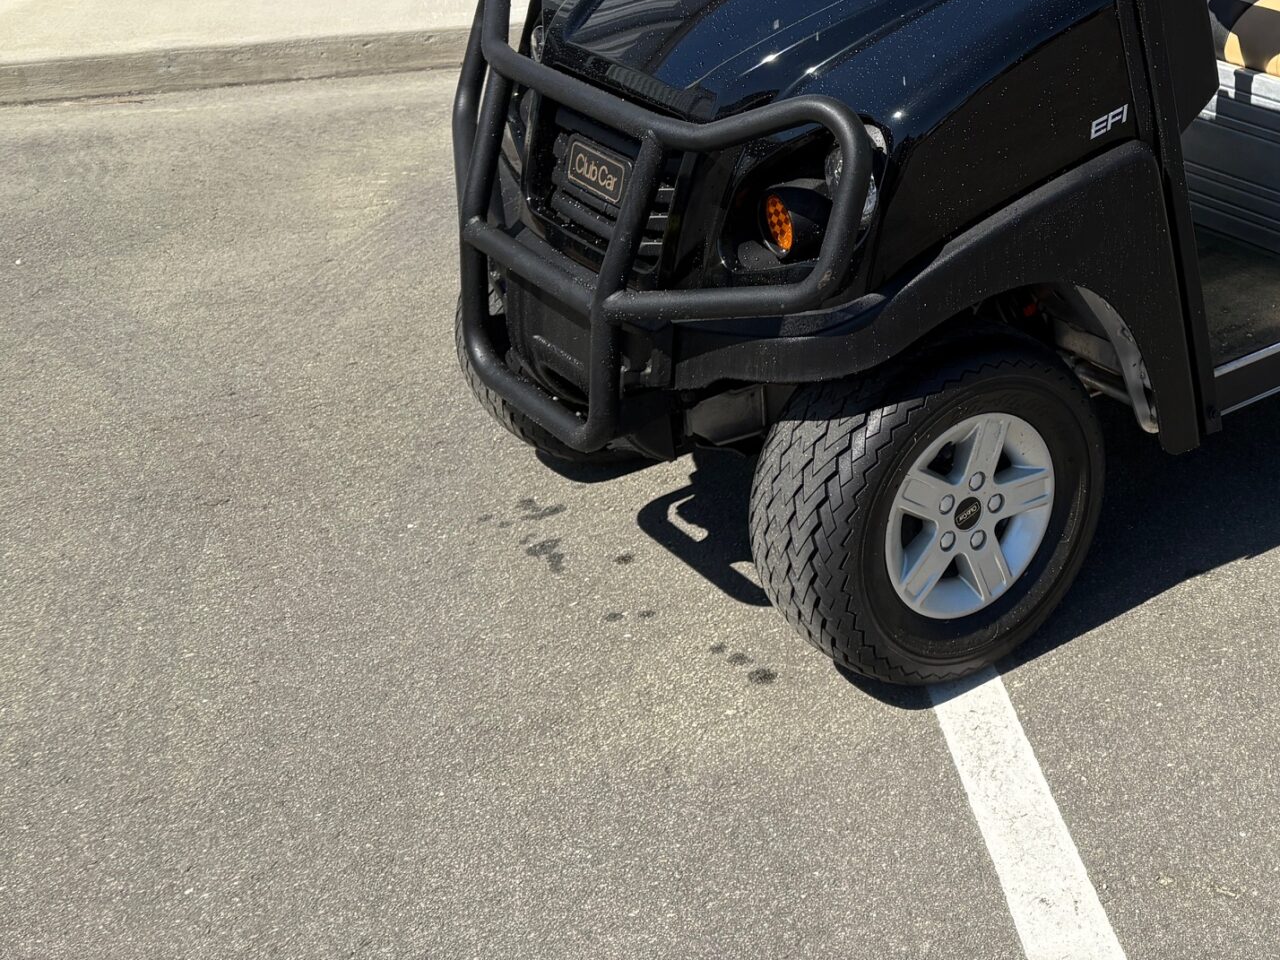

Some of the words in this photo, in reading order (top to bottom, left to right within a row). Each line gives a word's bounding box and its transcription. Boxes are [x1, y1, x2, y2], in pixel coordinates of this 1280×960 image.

[1090, 103, 1129, 141] EFI
[575, 153, 598, 182] Club
[598, 165, 618, 191] Car
